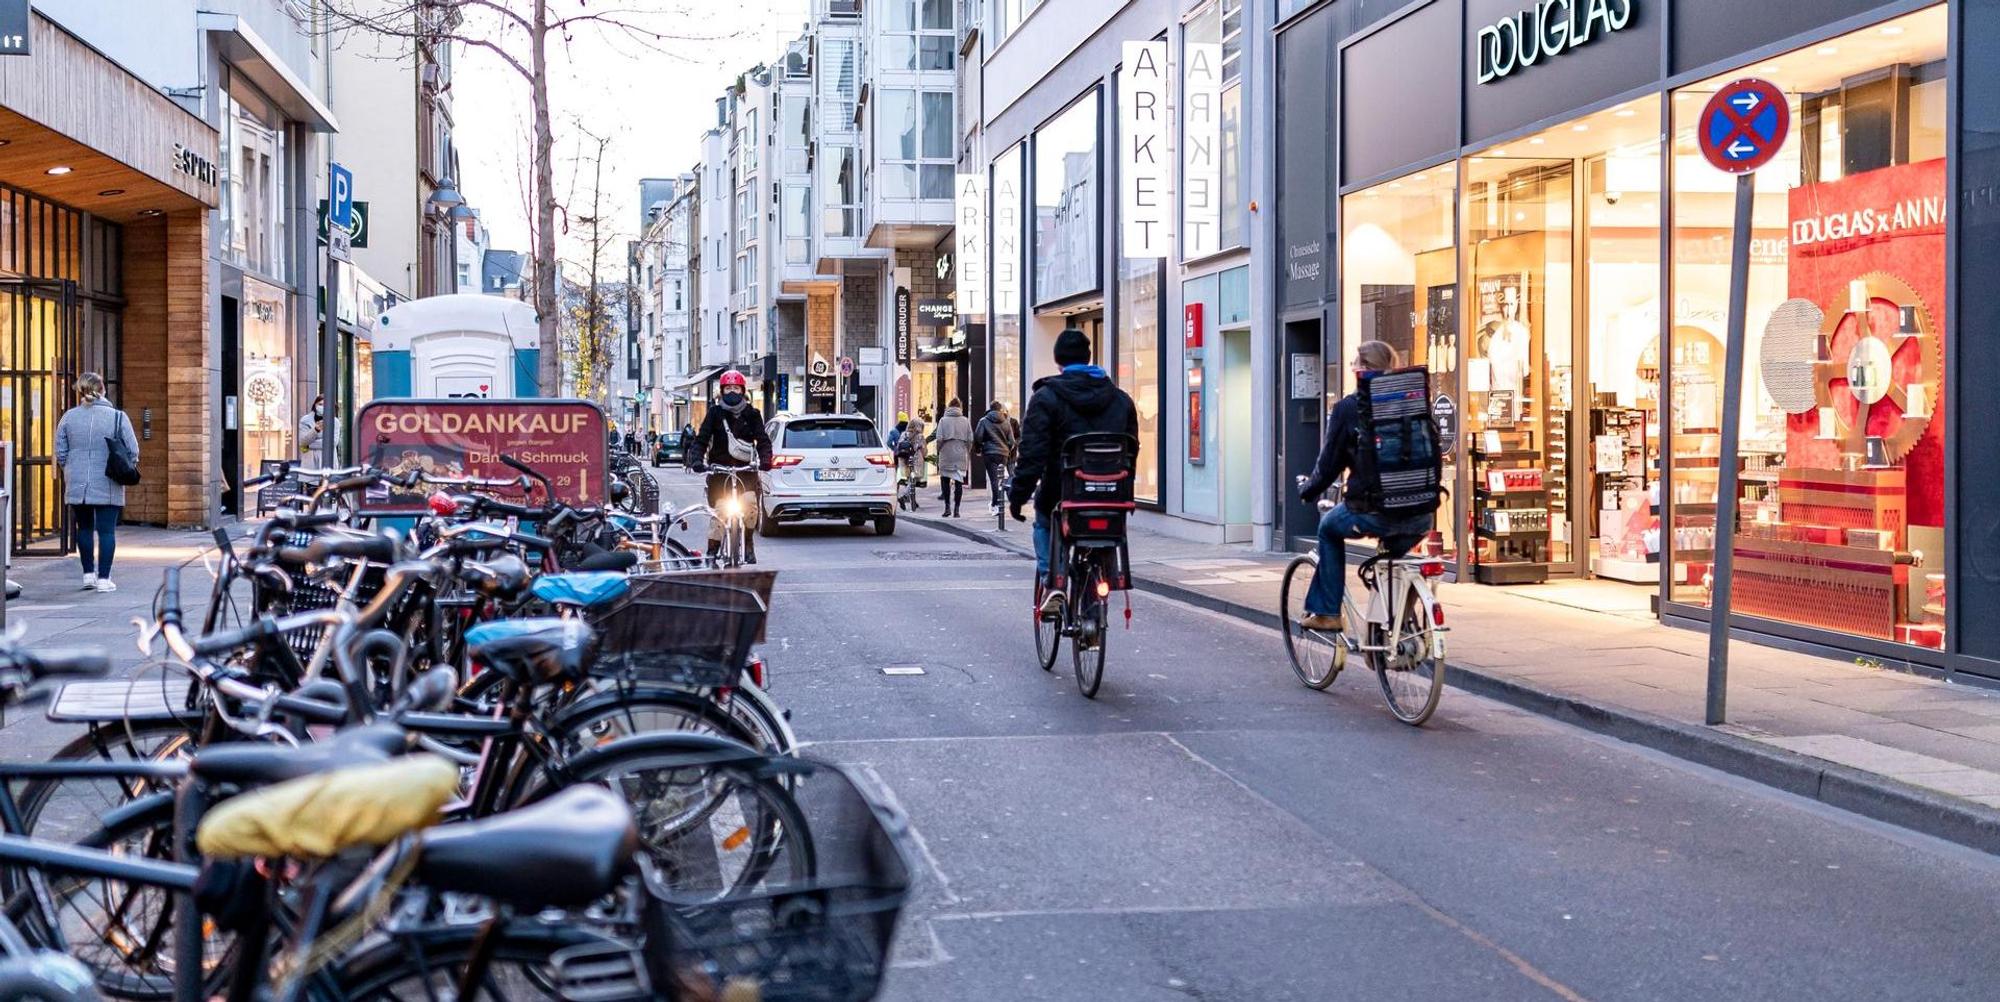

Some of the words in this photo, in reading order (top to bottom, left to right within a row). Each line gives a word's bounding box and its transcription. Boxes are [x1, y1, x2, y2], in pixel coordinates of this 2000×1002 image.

[1477, 0, 1631, 85] DOUGLAS
[173, 142, 217, 188] ESPRIT
[1134, 47, 1158, 250] ARKET
[336, 172, 348, 217] P
[962, 179, 979, 310] ARKET
[1792, 208, 1875, 246] DOUGLAS
[1290, 262, 1320, 281] Massage
[918, 304, 954, 314] CHANGE
[375, 412, 589, 435] GOLDANKAUF
[521, 450, 589, 464] Schmuck
[556, 475, 572, 488] 29
